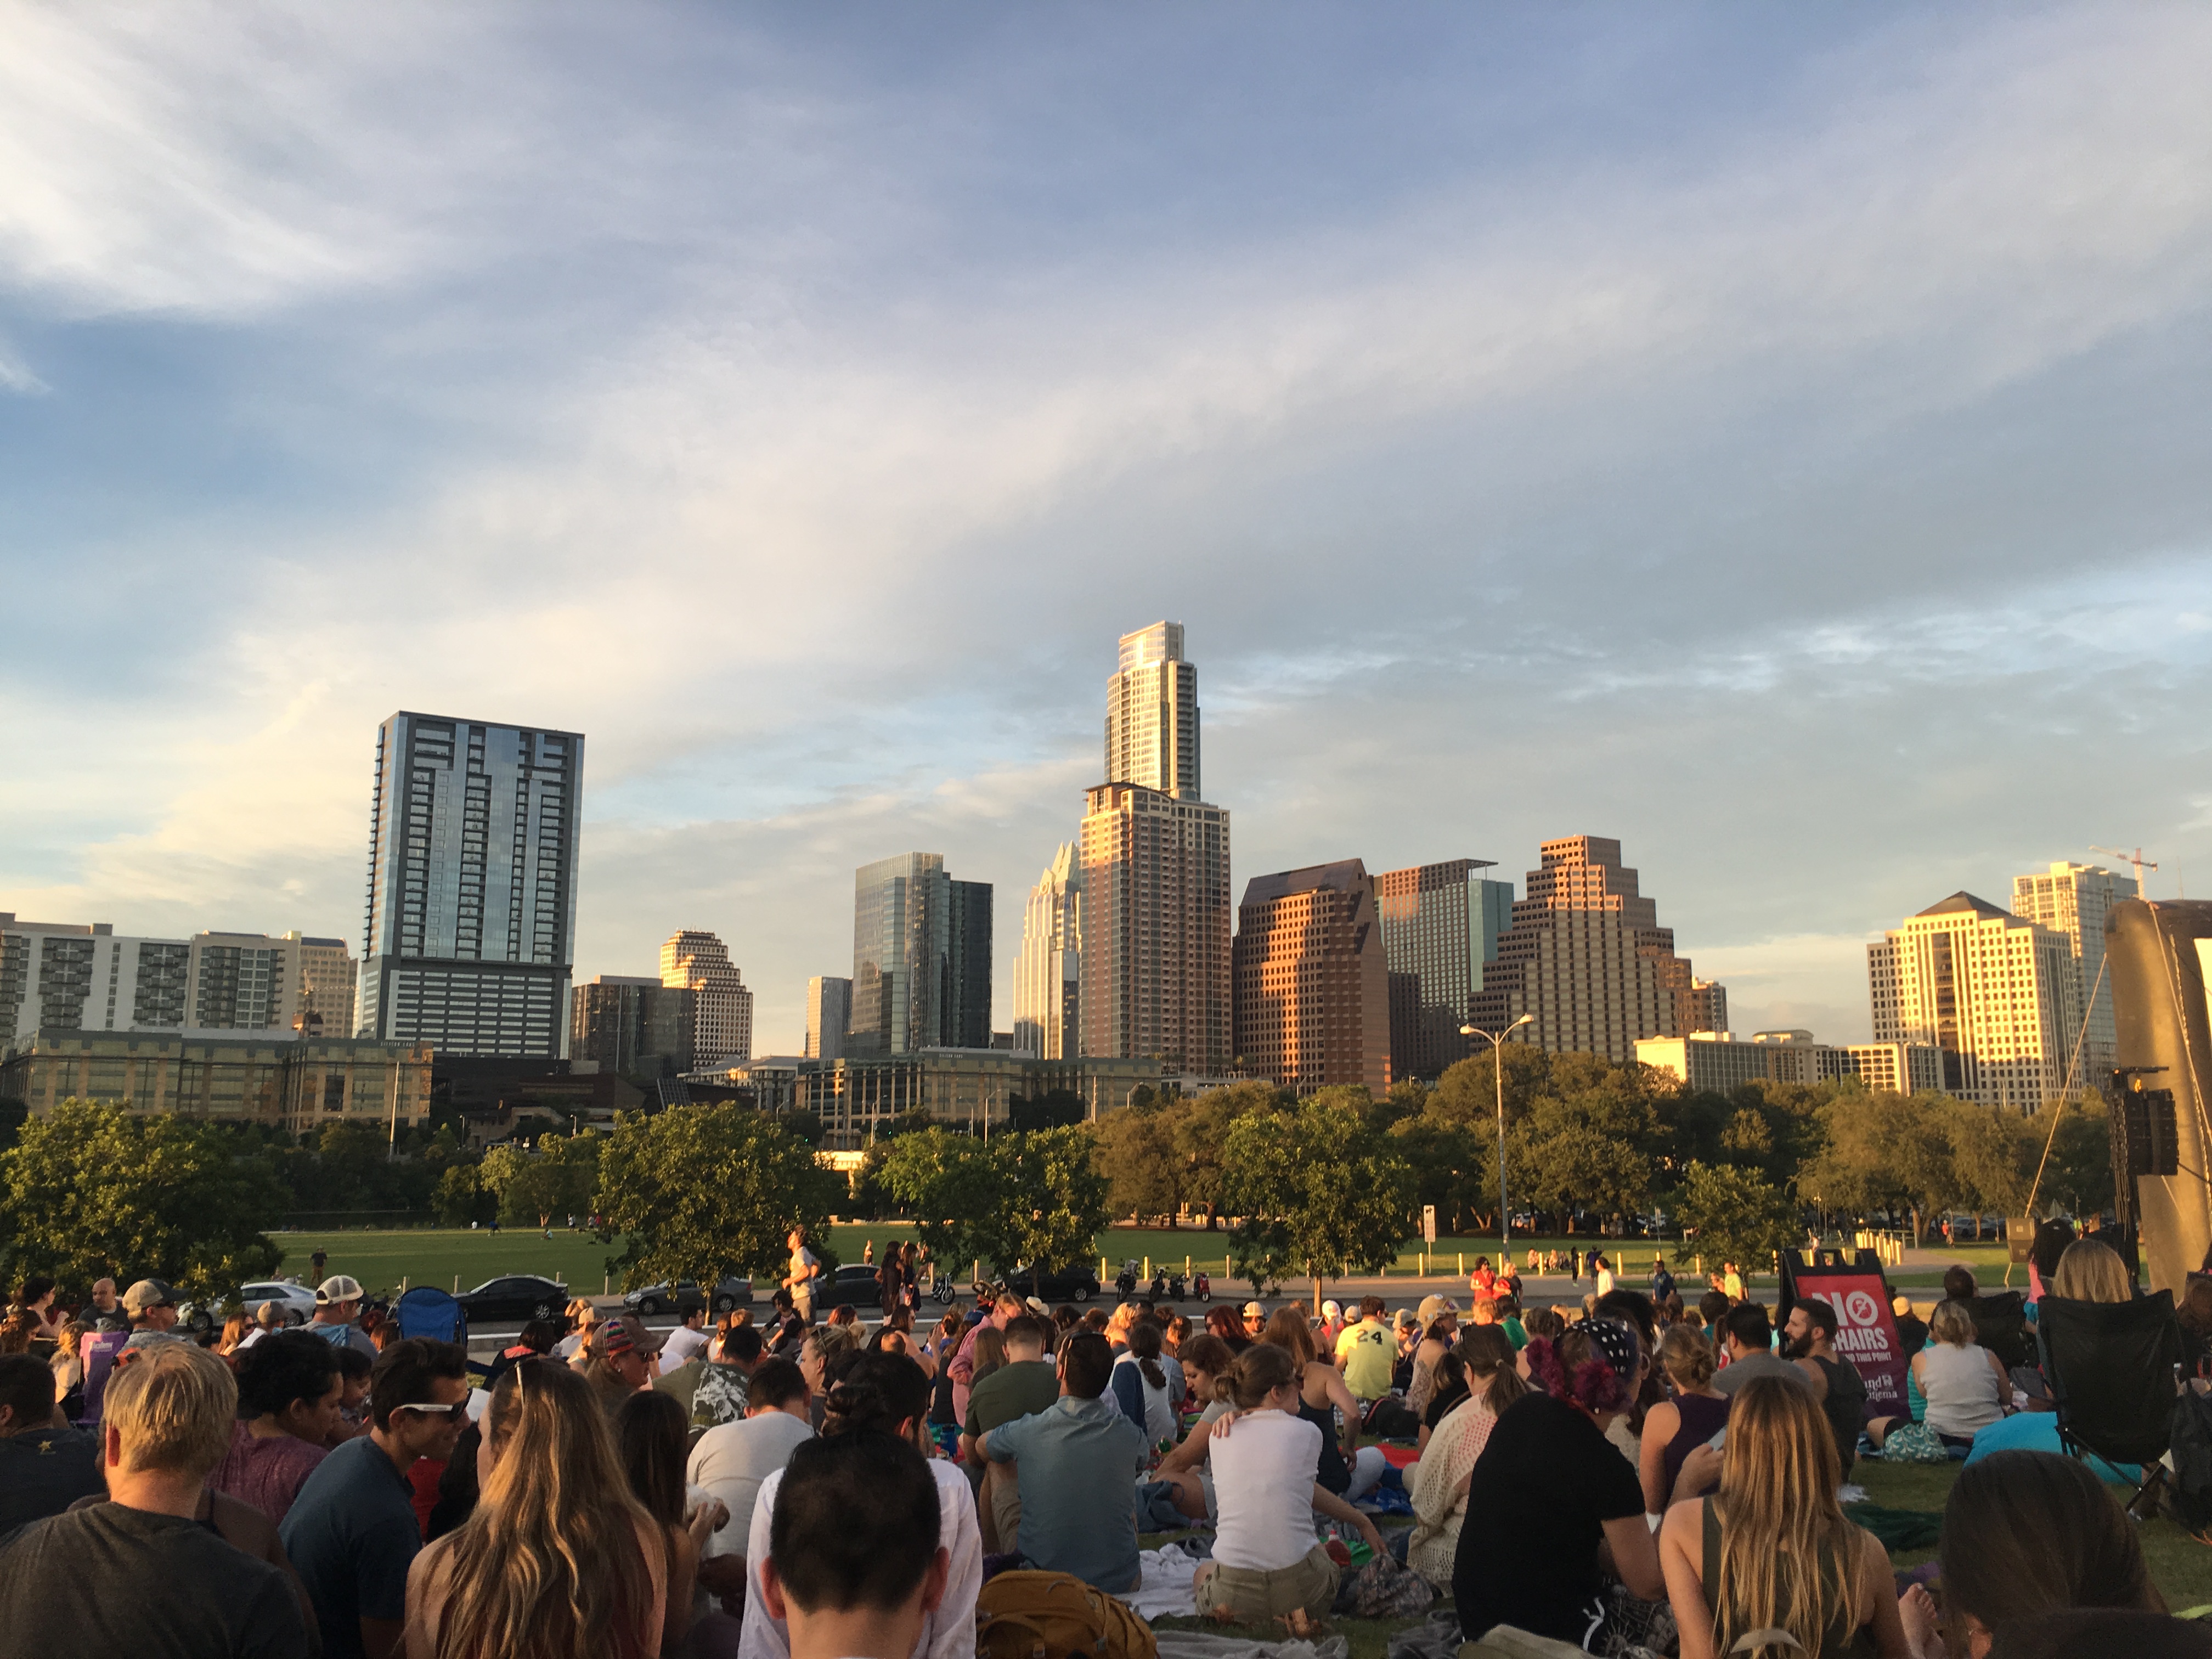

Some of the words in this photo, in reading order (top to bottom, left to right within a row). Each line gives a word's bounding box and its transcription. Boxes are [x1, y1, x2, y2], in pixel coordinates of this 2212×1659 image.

[1356, 1329, 1383, 1345] 24
[1832, 1327, 1888, 1351] HAIRS
[1866, 1391, 1897, 1402] inema
